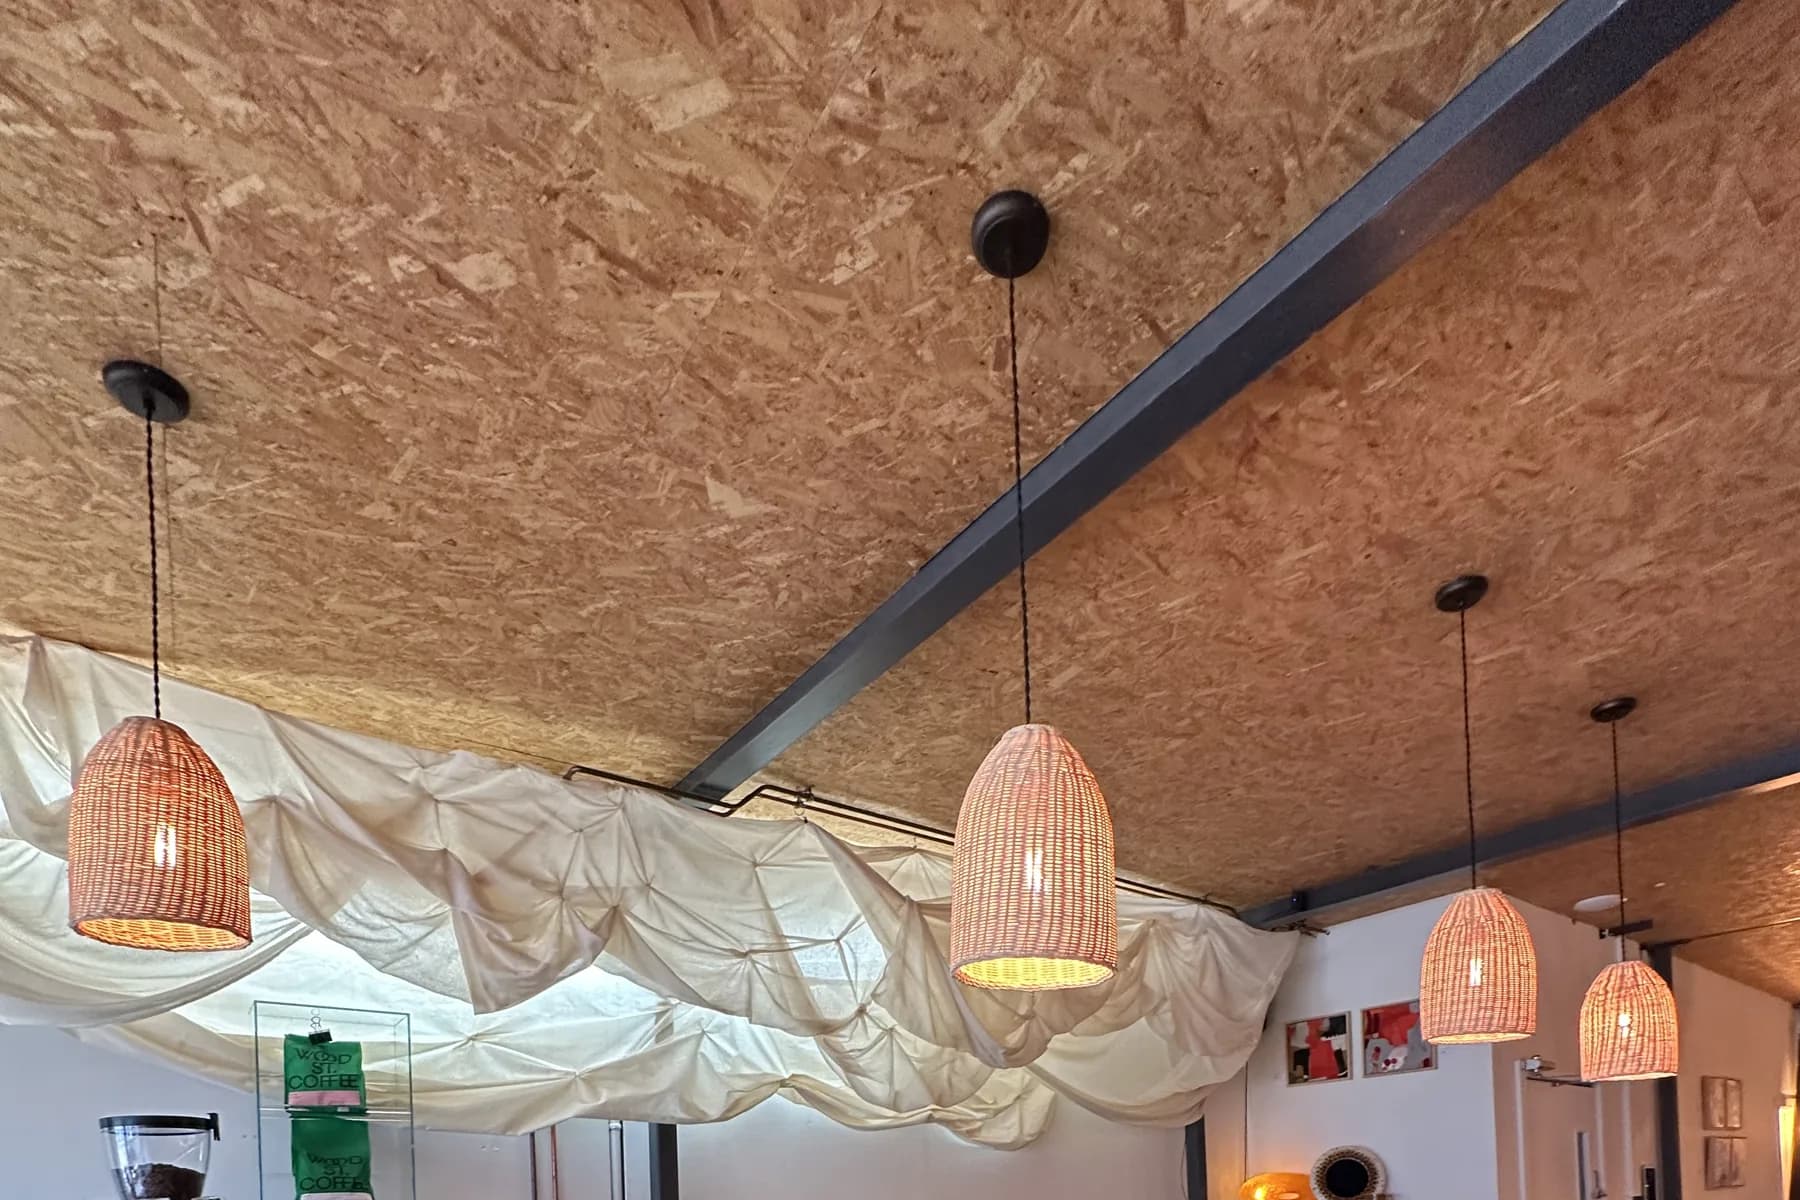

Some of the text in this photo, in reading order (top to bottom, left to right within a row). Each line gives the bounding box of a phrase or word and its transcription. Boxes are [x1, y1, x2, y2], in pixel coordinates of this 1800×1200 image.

[296, 1048, 352, 1064] WOOD
[312, 1062, 337, 1074] ST.
[289, 1073, 361, 1090] COFFEE
